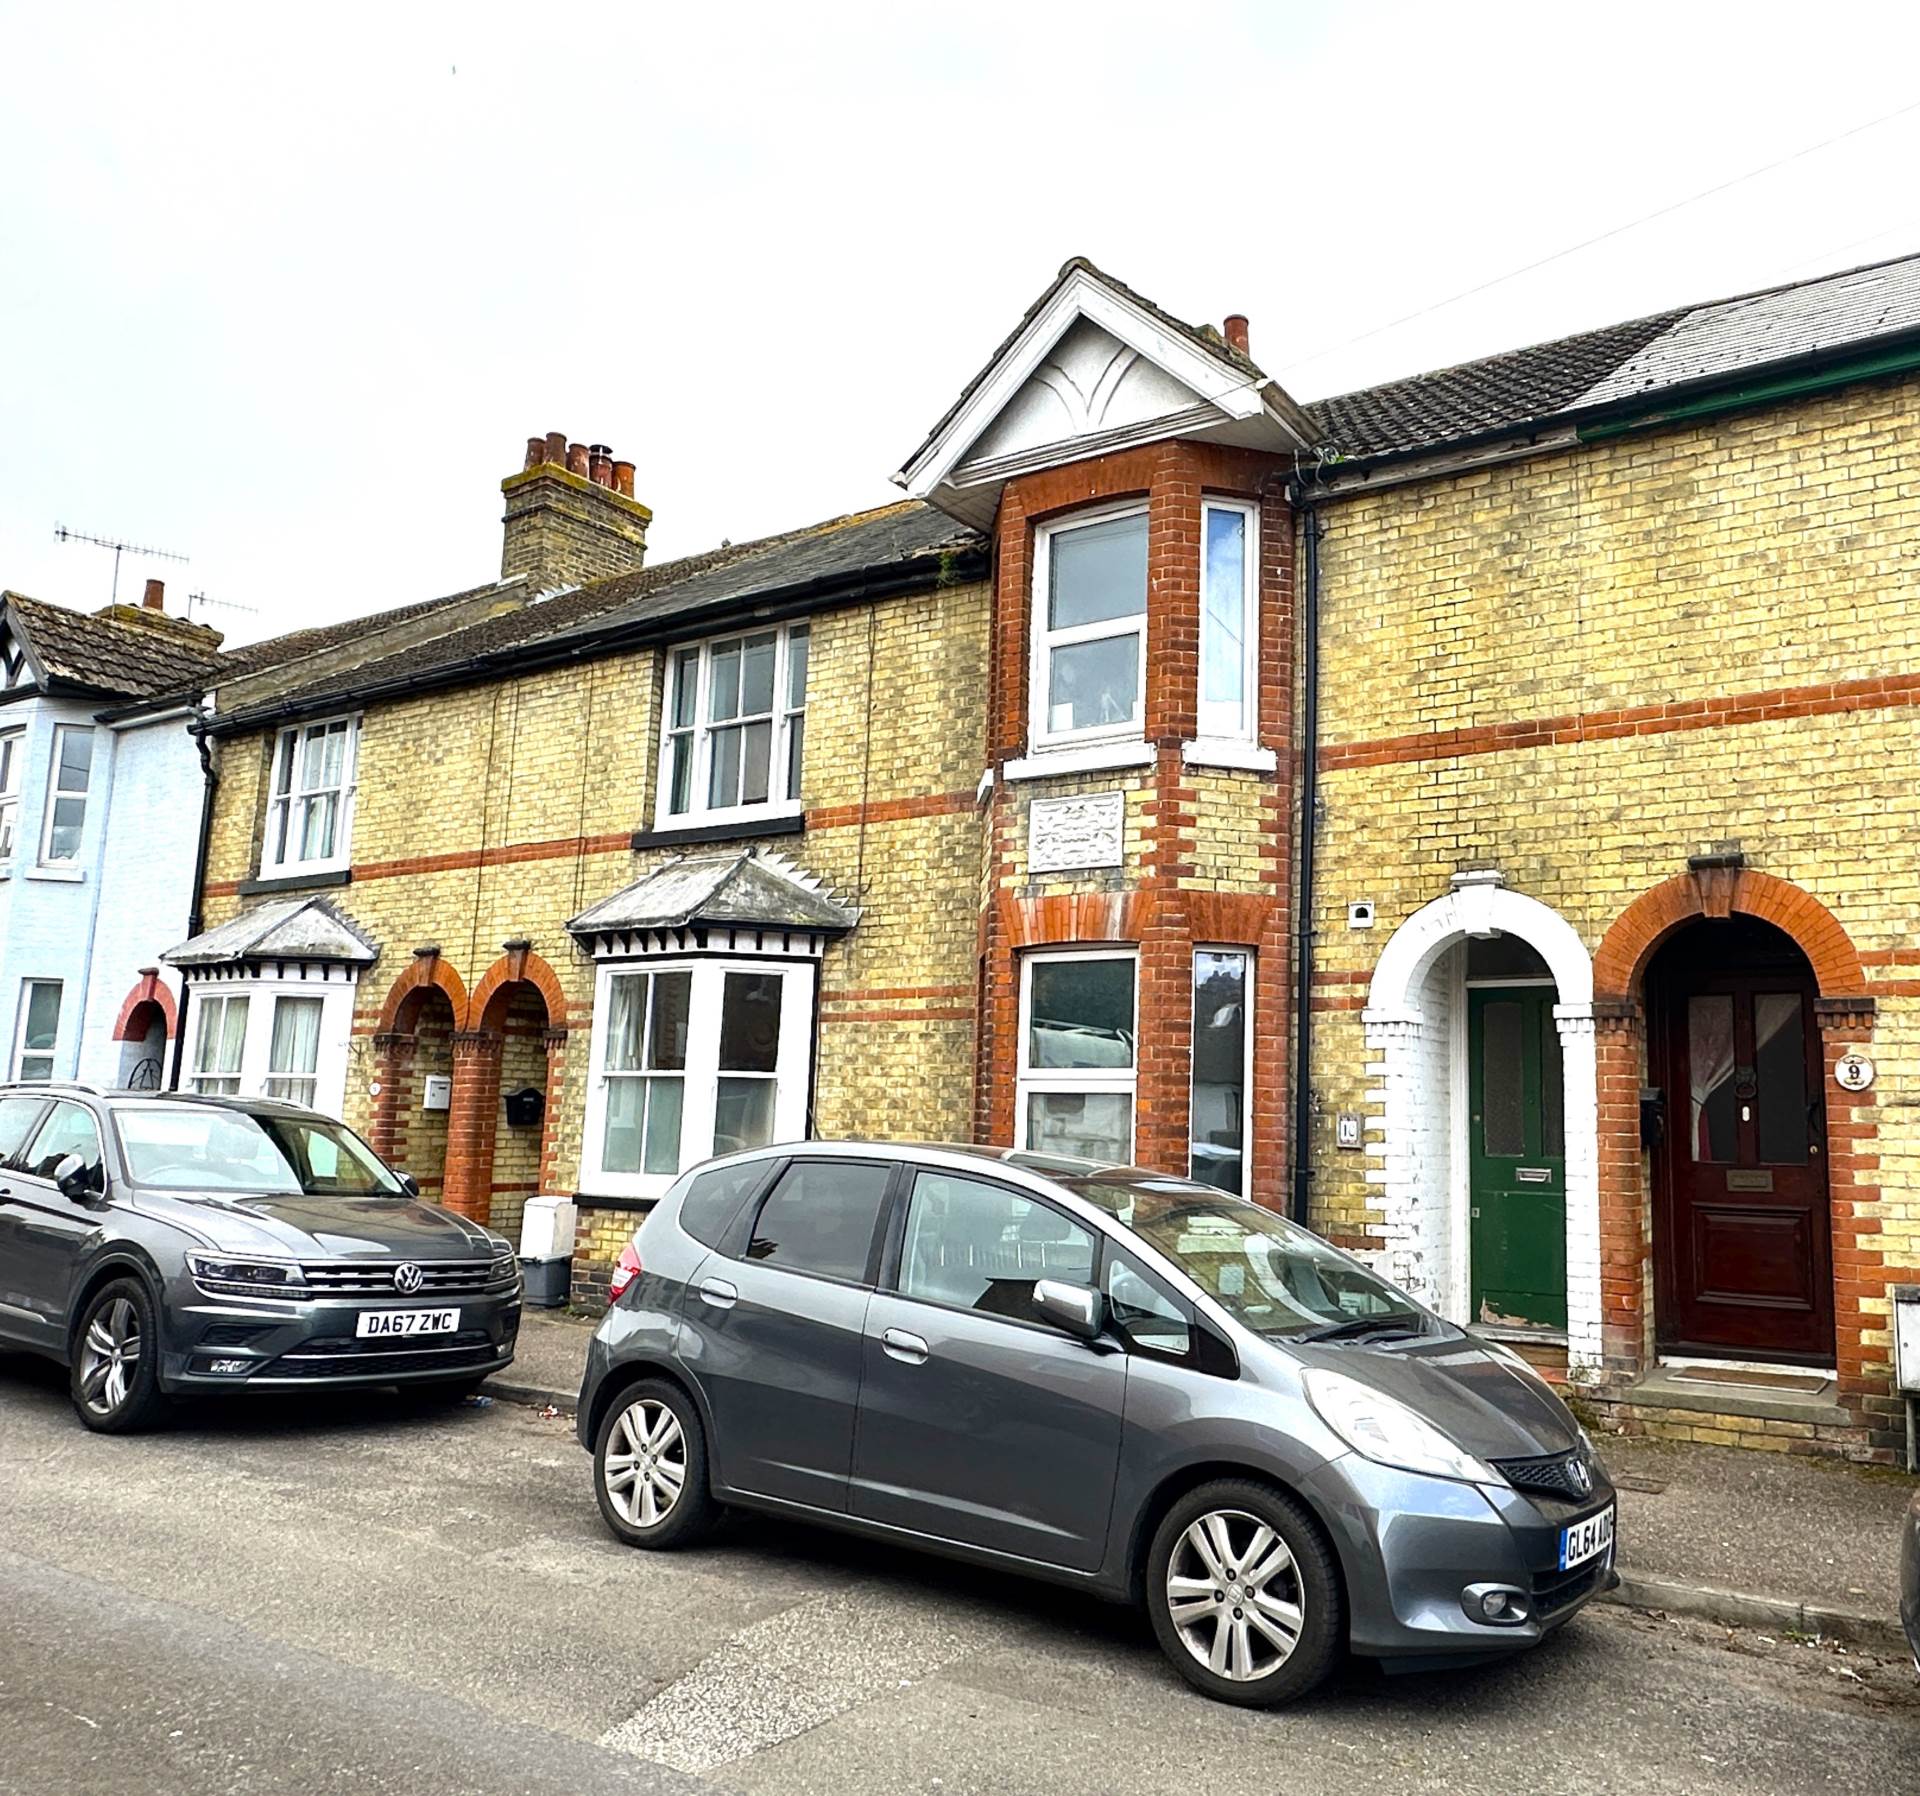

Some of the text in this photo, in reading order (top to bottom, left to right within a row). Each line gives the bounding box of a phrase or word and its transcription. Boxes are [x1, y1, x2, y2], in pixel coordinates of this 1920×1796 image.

[1848, 1065, 1860, 1080] 9
[396, 1263, 423, 1292] VW
[367, 1312, 453, 1334] DA67 ZWC
[1568, 1522, 1596, 1562] GL64
